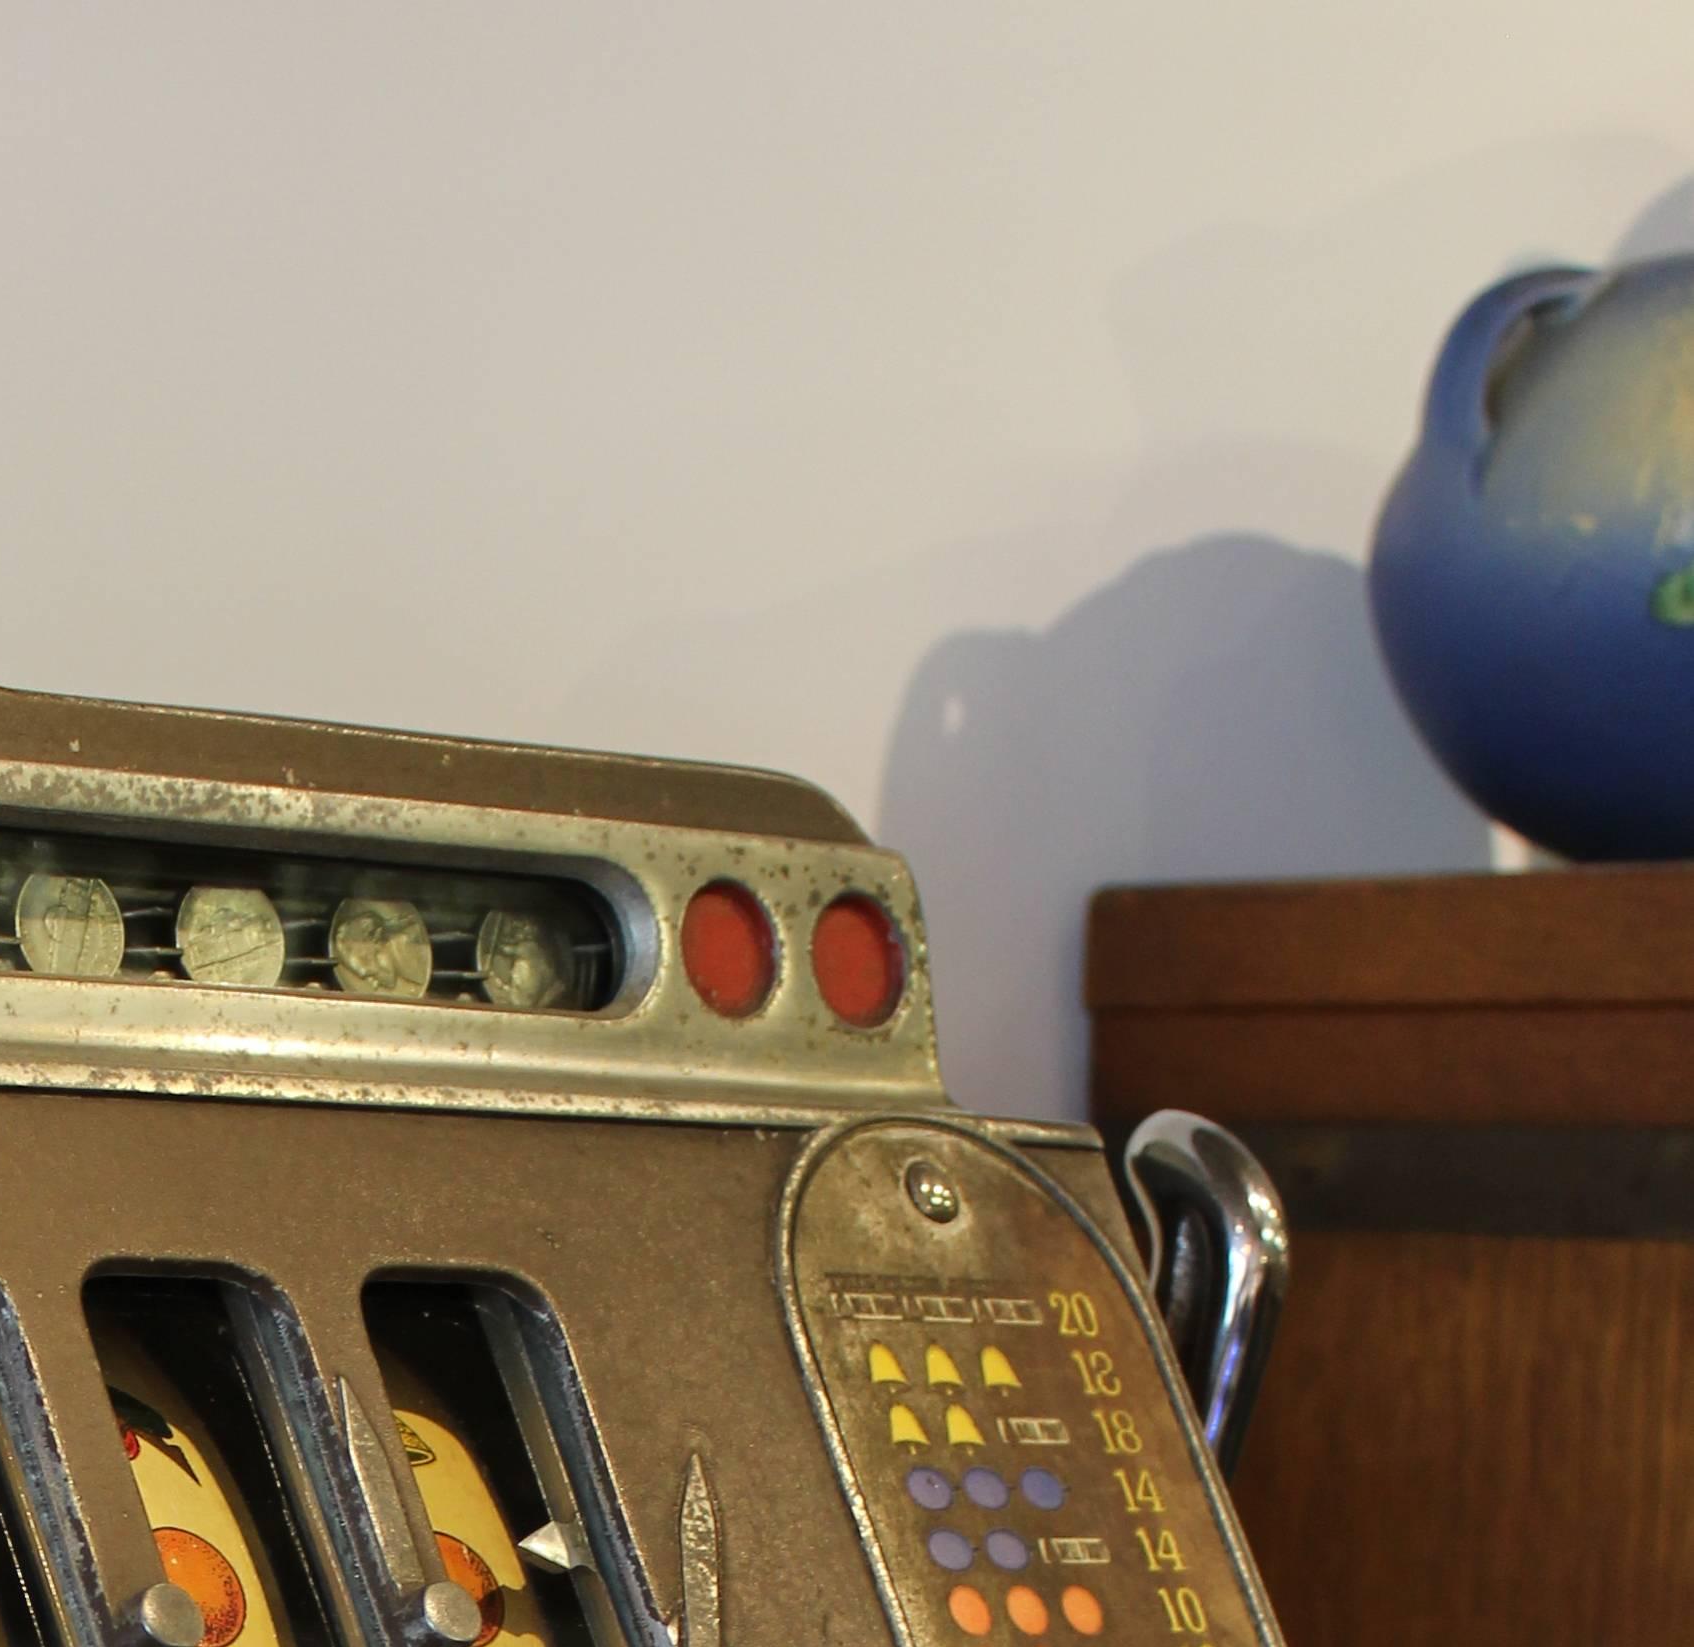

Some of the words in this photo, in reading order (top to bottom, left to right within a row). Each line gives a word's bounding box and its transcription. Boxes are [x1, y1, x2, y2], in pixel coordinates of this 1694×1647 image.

[1048, 1291, 1099, 1338] 20
[1091, 1408, 1144, 1455] 18
[1113, 1468, 1166, 1513] 14
[1135, 1527, 1187, 1572] 14
[1157, 1586, 1207, 1634] 10
